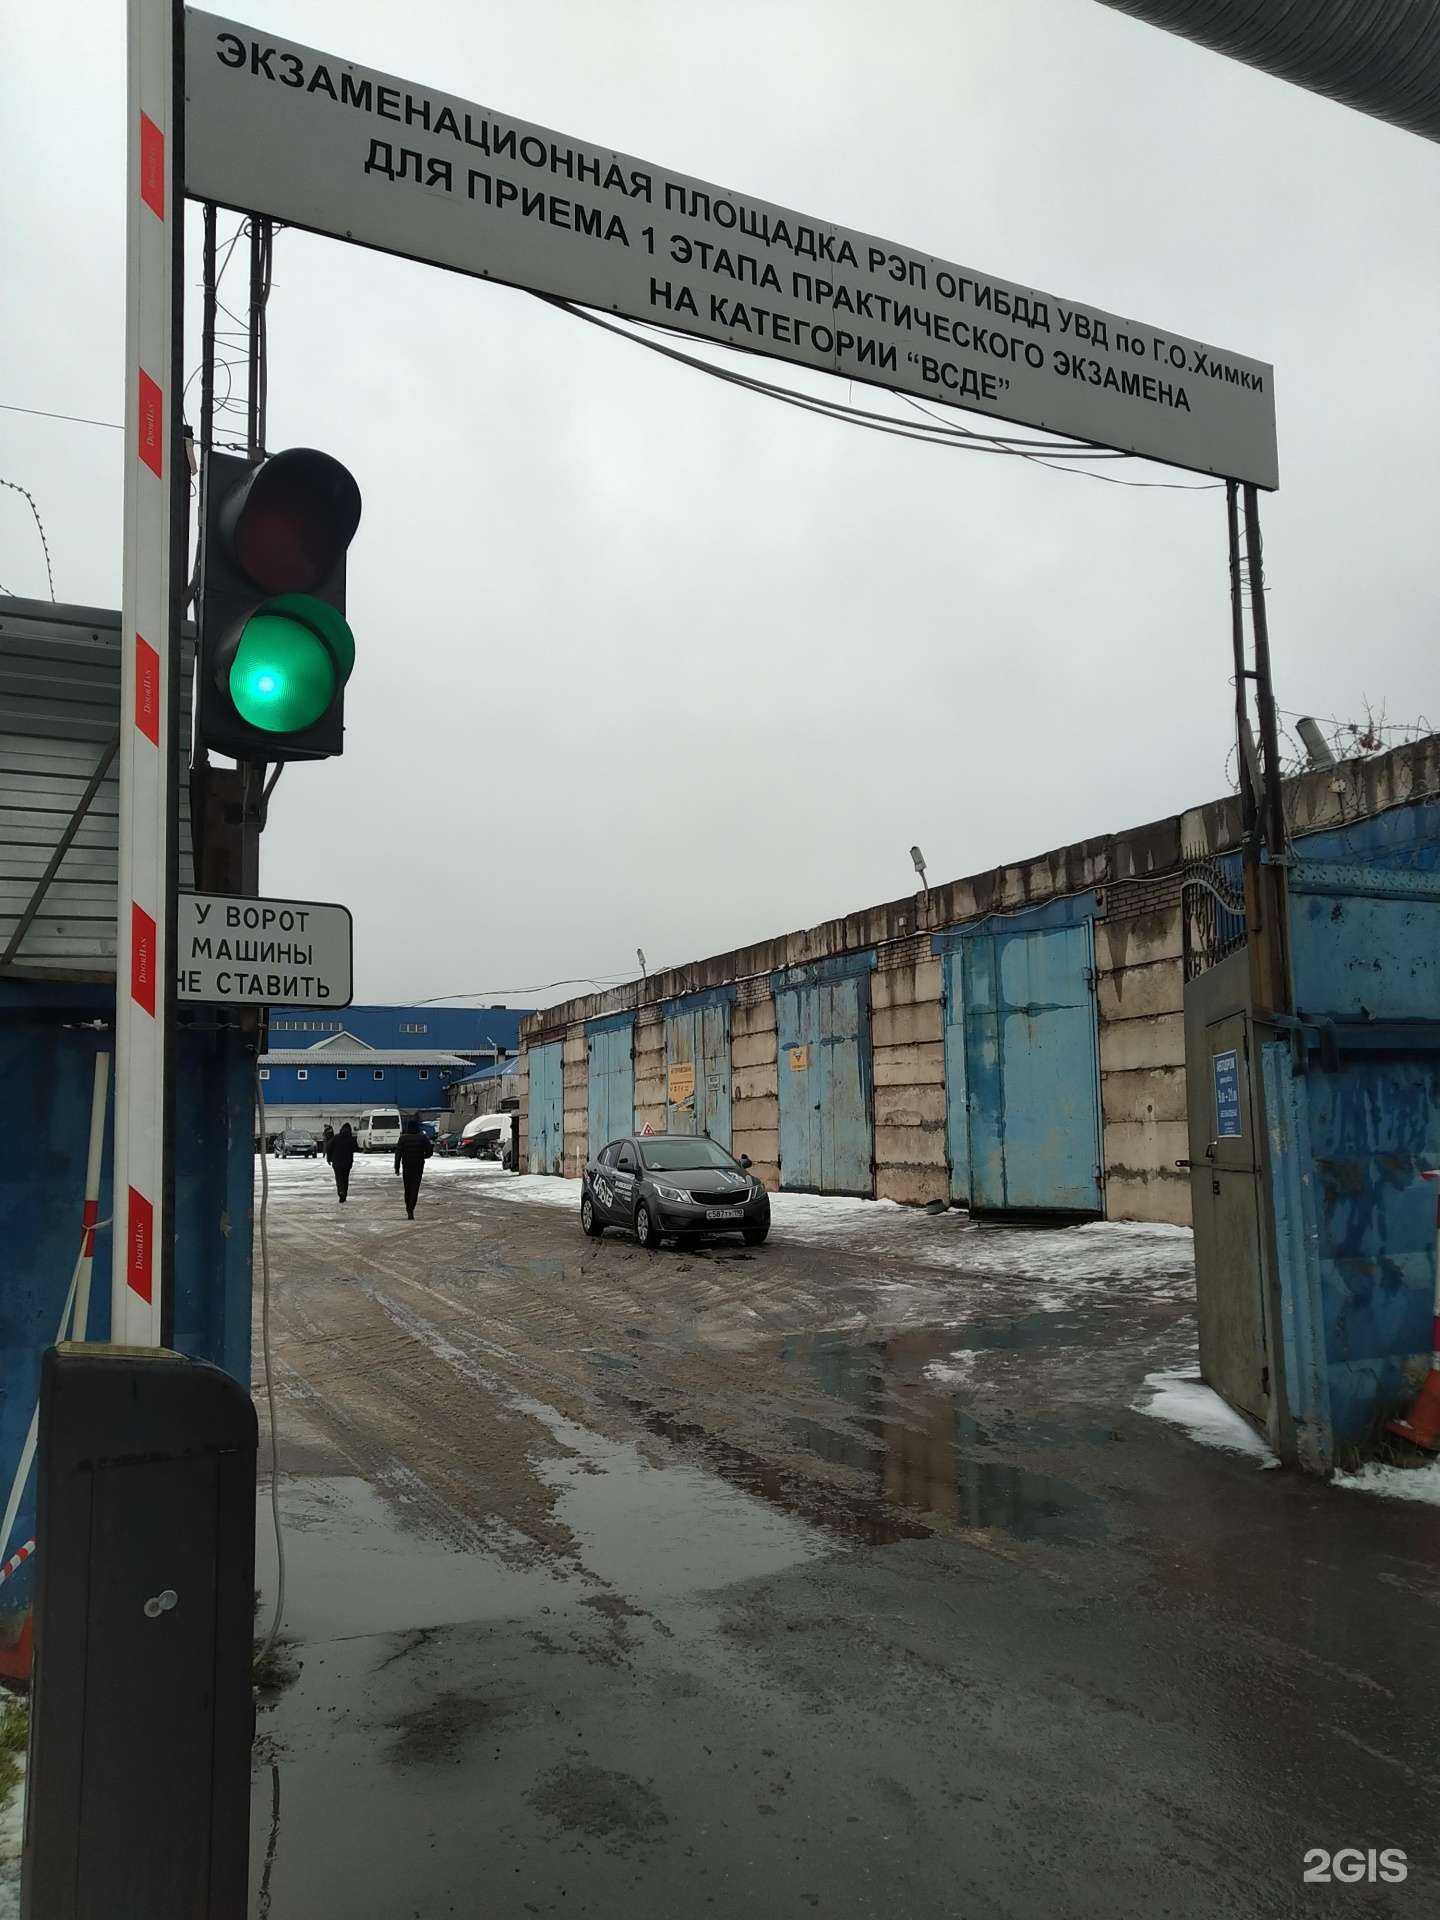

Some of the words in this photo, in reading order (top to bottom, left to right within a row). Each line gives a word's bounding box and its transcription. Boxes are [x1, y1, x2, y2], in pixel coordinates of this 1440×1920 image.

[215, 32, 652, 204] ЭКЗАМЕНАЦИОННАЯ
[665, 182, 859, 269] ПЛОЩАДКА
[868, 247, 927, 291] РЭП
[935, 271, 1051, 334] ОГИБДД
[1057, 307, 1109, 353] УВД
[1115, 333, 1146, 357] по
[363, 138, 453, 193] ДЛЯ
[467, 168, 630, 248] ПРИЕМА
[641, 226, 656, 255] 1
[669, 234, 783, 294] ЭТАПА
[792, 271, 1045, 369] ПРАКТИЧЕСКОГО
[1052, 350, 1192, 413] ЭКЗАМЕНА
[649, 276, 700, 318] НА
[710, 293, 897, 372] КАТЕГОРИИ
[194, 902, 212, 925] У
[226, 905, 310, 933] ВОРОТ
[190, 936, 313, 966] МАШИНЫ
[216, 971, 331, 999] СТАВИТЬ
